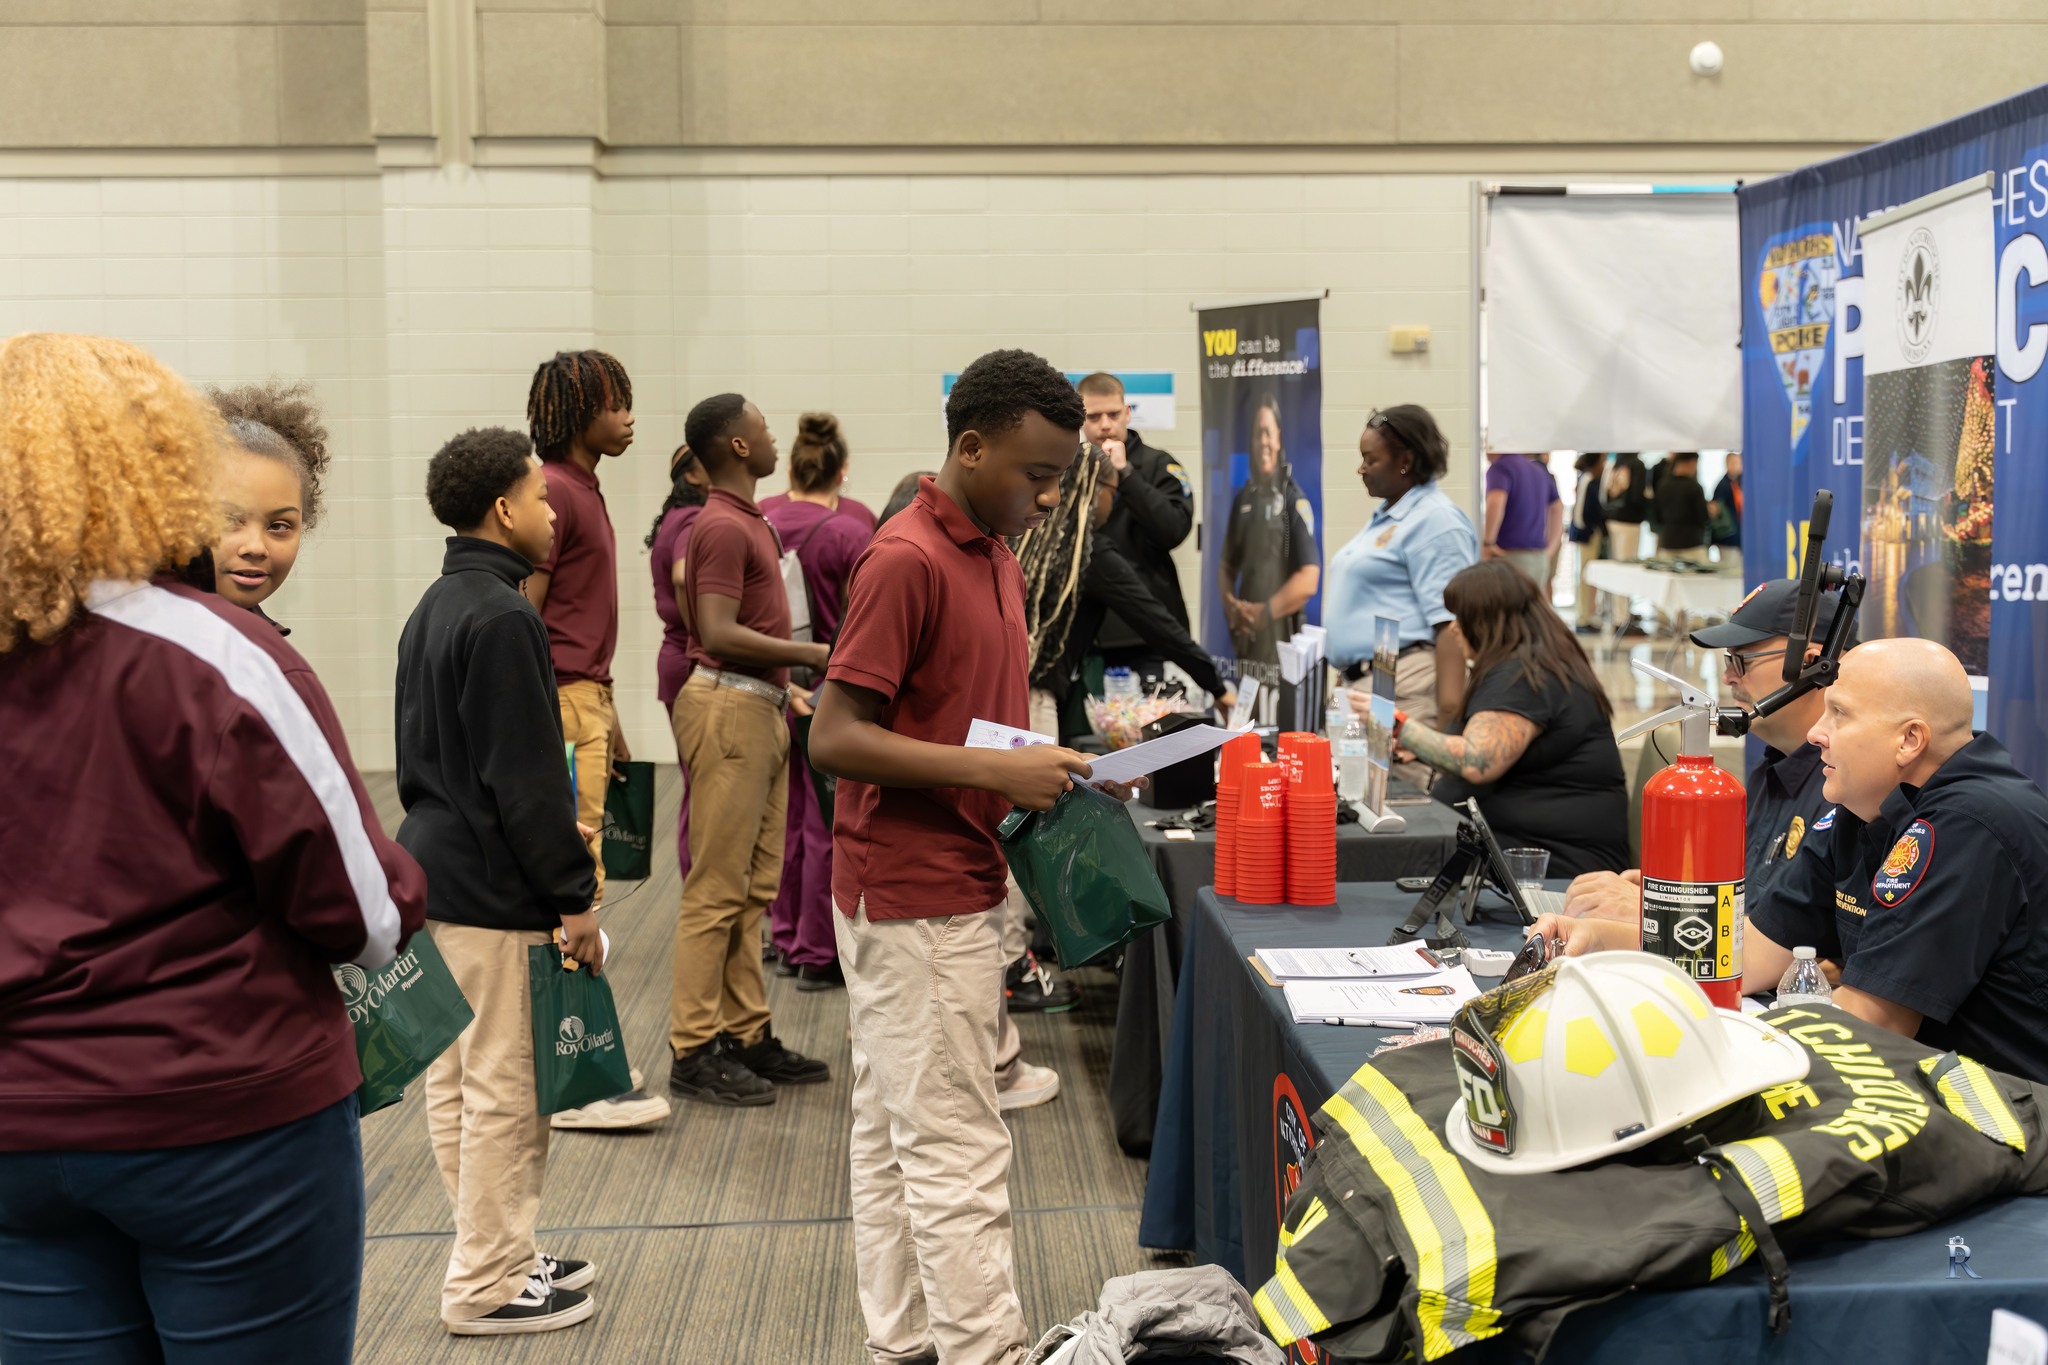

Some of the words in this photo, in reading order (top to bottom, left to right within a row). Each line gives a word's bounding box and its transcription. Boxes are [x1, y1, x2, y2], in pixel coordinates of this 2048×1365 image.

[1203, 328, 1237, 357] YOU
[1238, 340, 1262, 355] can
[1264, 334, 1281, 353] be
[1208, 361, 1230, 379] the
[1647, 882, 1659, 891] FIRE
[1659, 884, 1709, 895] EXTINGUISHER
[1721, 895, 1731, 908] A
[1844, 894, 1857, 905] LEO
[1721, 925, 1730, 938] B
[1720, 954, 1729, 967] C
[400, 967, 424, 992] Plywood
